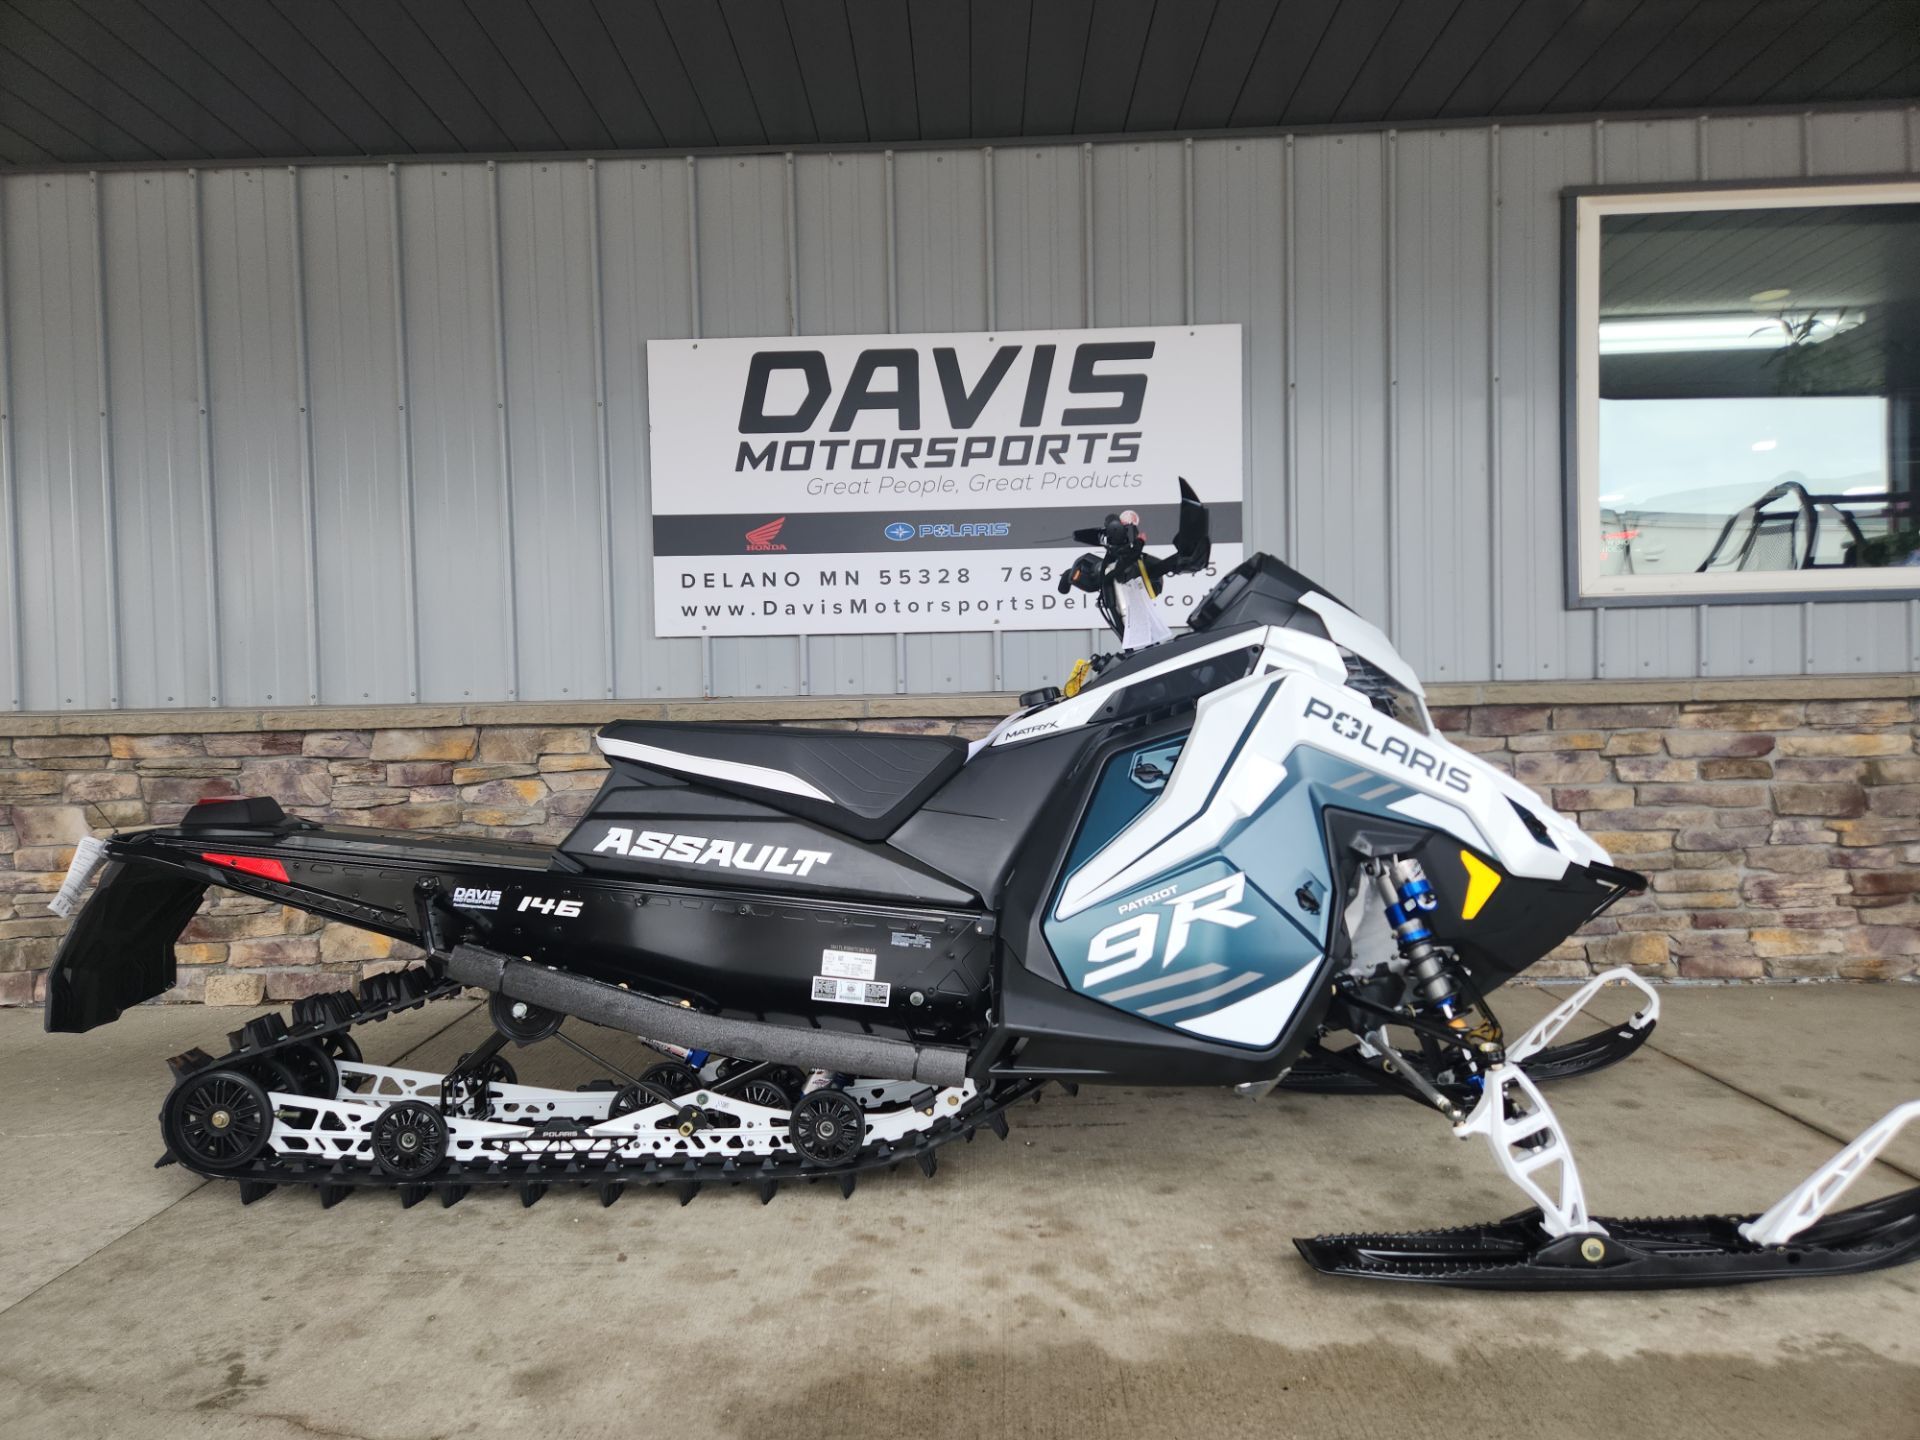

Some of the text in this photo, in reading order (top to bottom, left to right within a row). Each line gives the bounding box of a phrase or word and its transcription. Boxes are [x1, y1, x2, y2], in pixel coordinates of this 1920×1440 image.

[738, 341, 1156, 434] DAVIS
[735, 432, 1143, 472] MOTORSPORTS
[806, 471, 1144, 497] Great People, Great Products
[919, 522, 1010, 538] POLARIS
[746, 543, 788, 551] HONDA
[681, 568, 970, 588] DELANO MN 55328
[1005, 720, 1059, 740] MATRYX
[1303, 696, 1472, 794] POLARIS
[593, 827, 832, 877] ASSAULT
[453, 887, 502, 900] DAVIS
[1118, 884, 1179, 916] PATRIOT
[517, 896, 584, 918] 146
[1083, 870, 1257, 989] 9R
[543, 1130, 578, 1138] POLARIS
